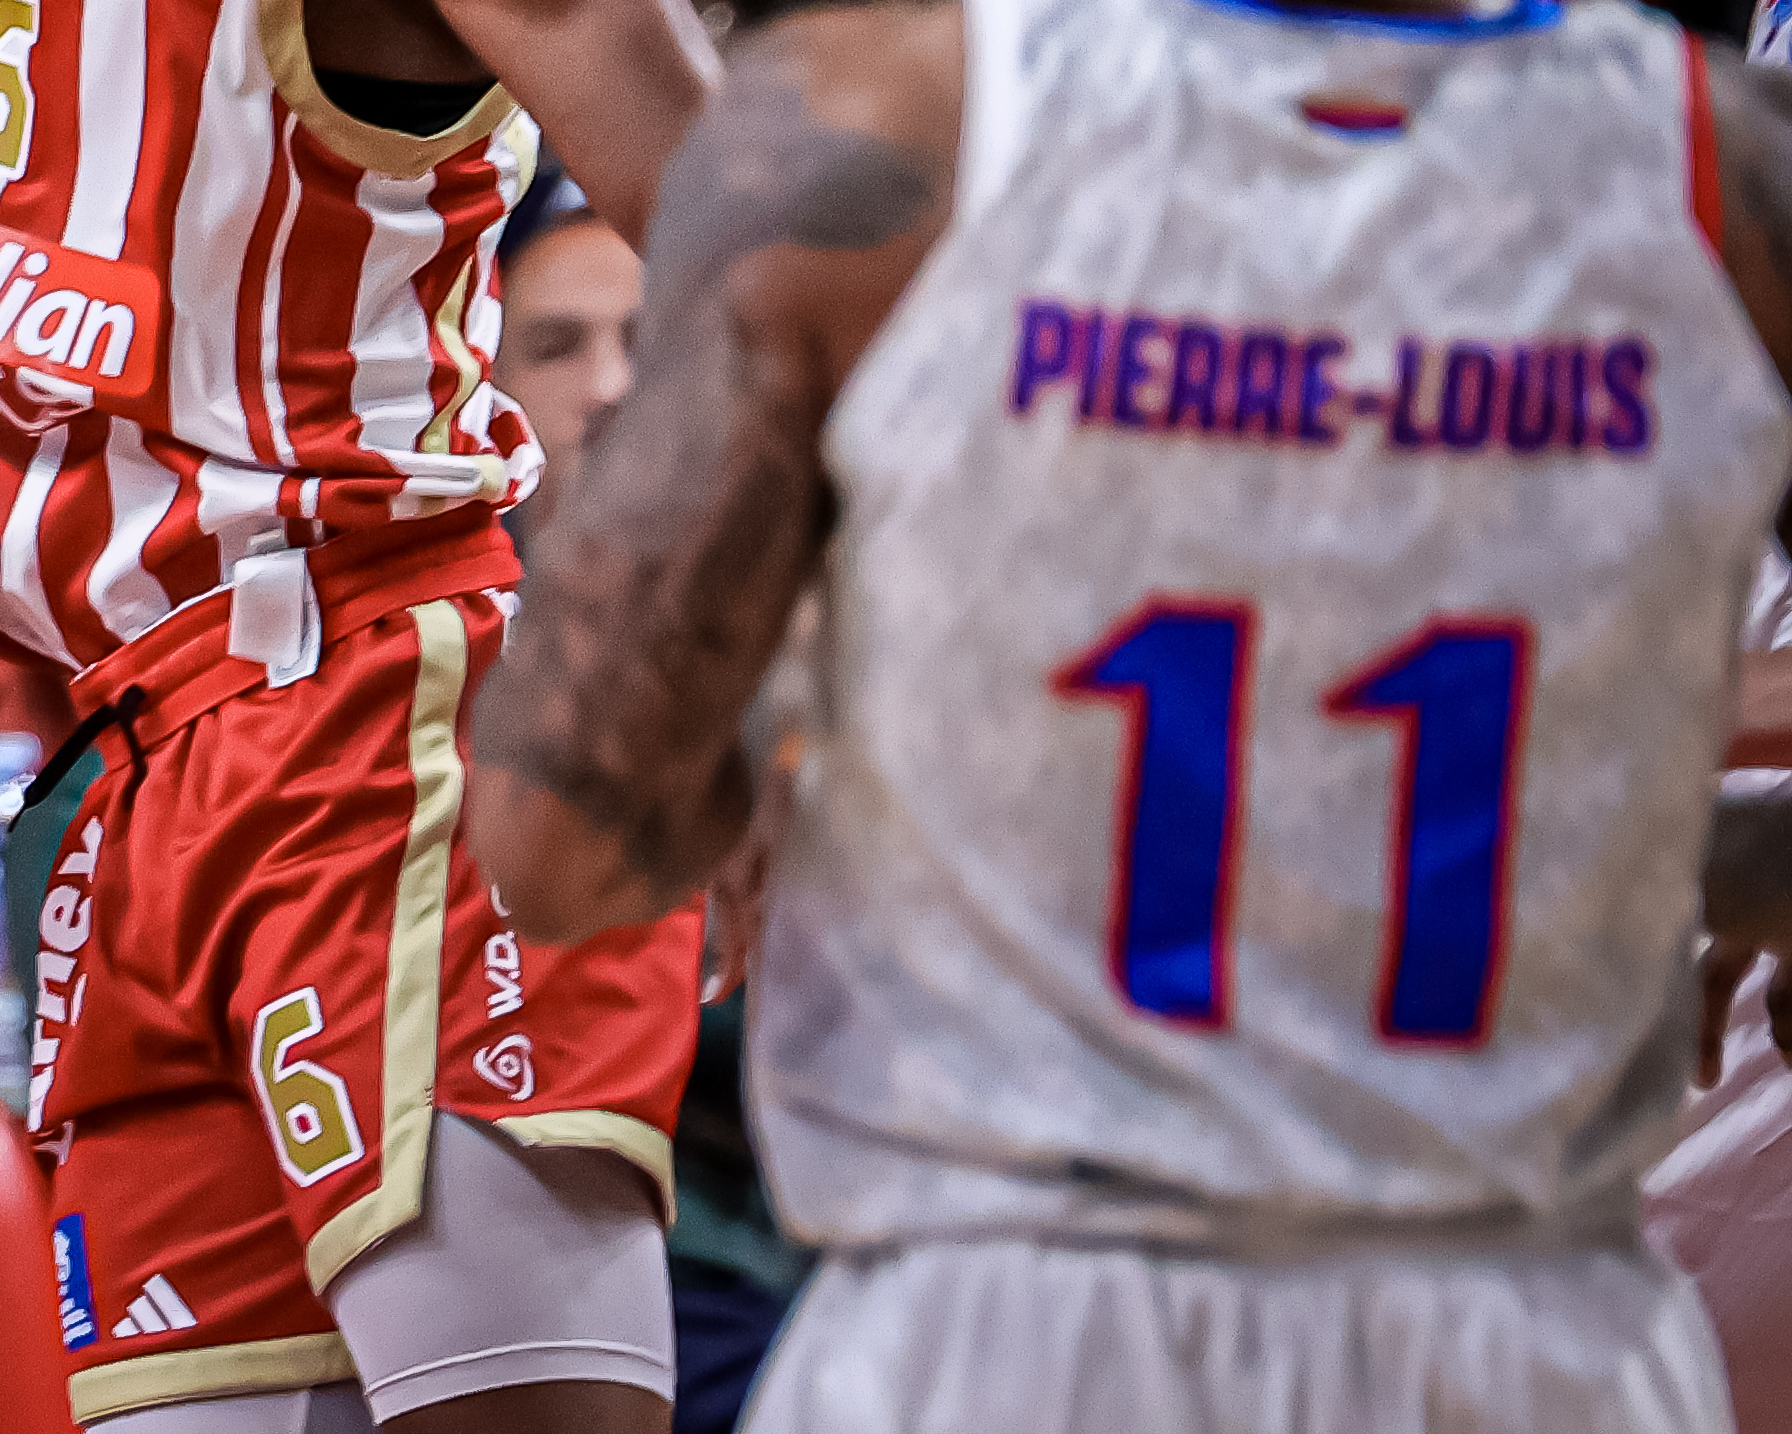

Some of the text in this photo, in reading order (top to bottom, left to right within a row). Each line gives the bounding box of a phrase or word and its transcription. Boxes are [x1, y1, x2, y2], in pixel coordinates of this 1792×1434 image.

[1010, 298, 1658, 462] PIERRE-LOUIS
[1050, 592, 1539, 1048] 11
[251, 987, 364, 1188] 6
